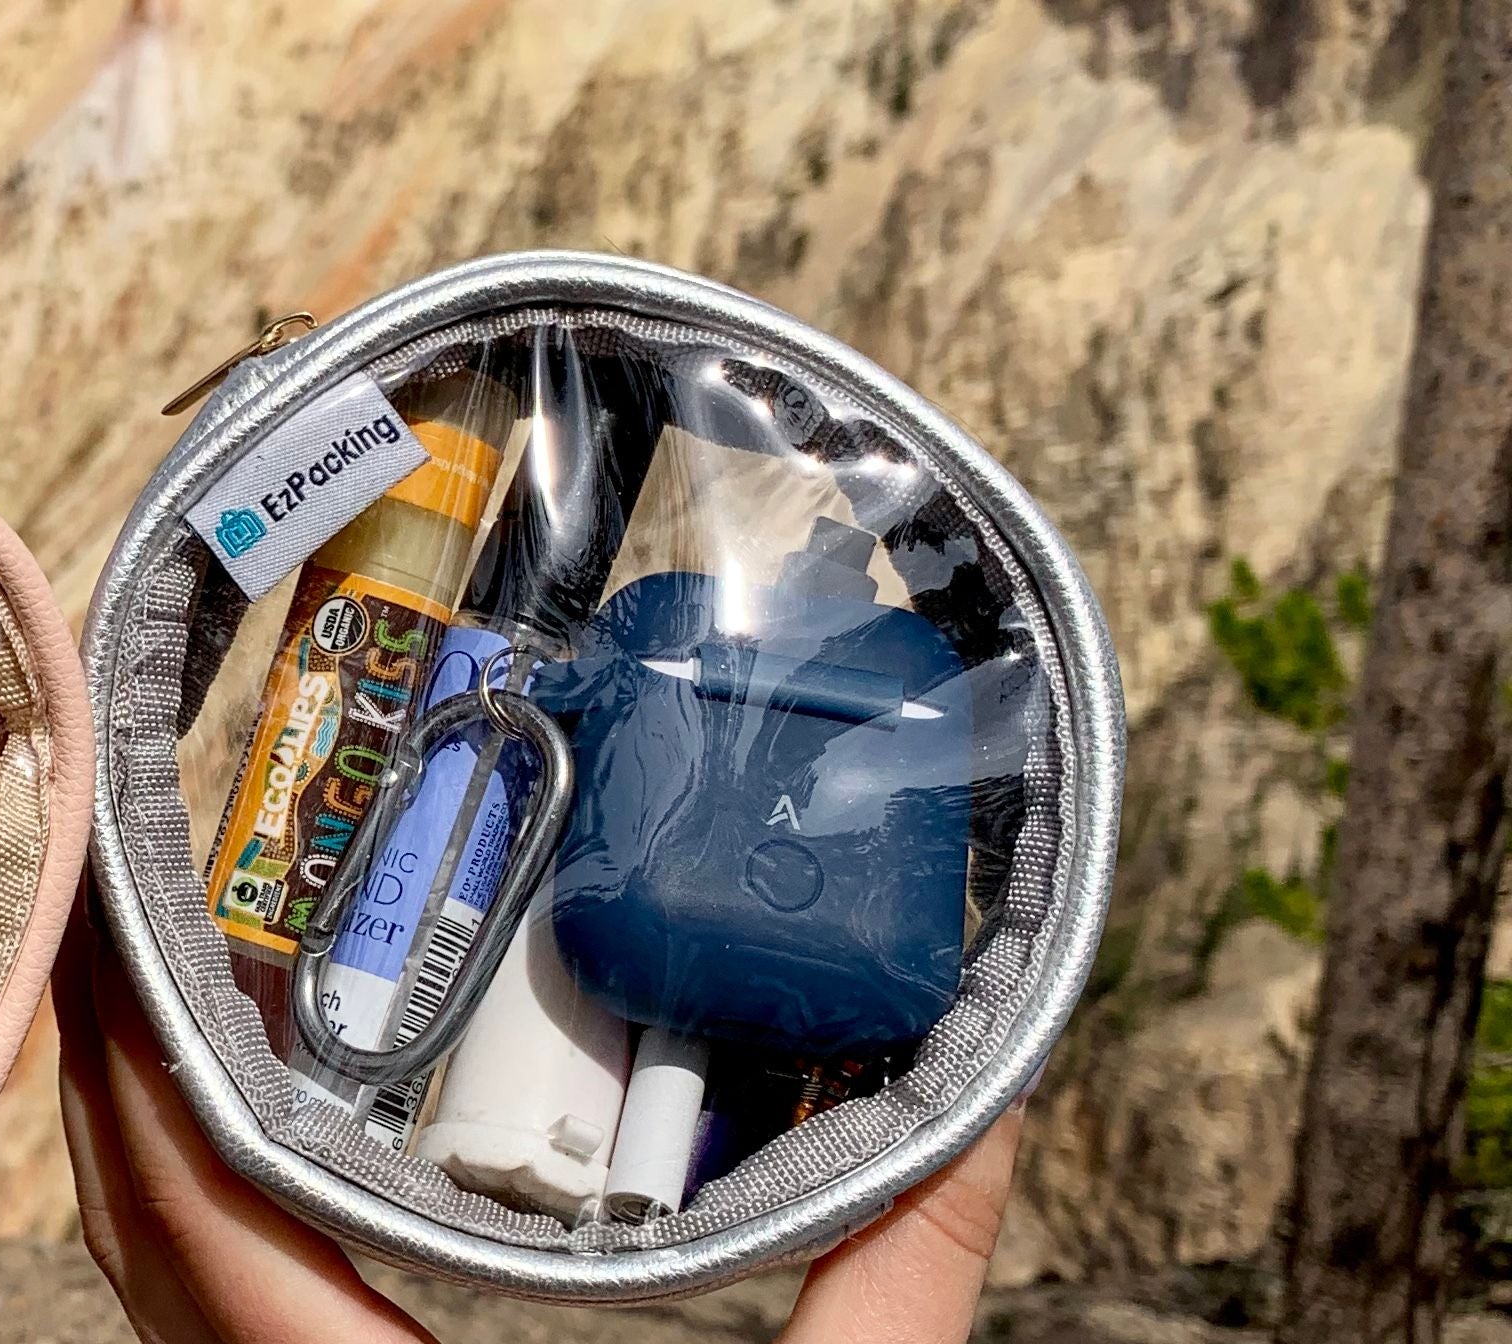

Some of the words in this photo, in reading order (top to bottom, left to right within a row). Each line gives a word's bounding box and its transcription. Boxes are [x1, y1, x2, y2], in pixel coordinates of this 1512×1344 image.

[261, 413, 401, 523] EzPacking
[320, 607, 341, 640] USDA
[334, 606, 356, 648] ORGANIC
[253, 765, 295, 839] ECO
[281, 673, 330, 753] LIPS
[467, 801, 501, 877] PRODUCTS
[392, 1137, 404, 1152] 6
